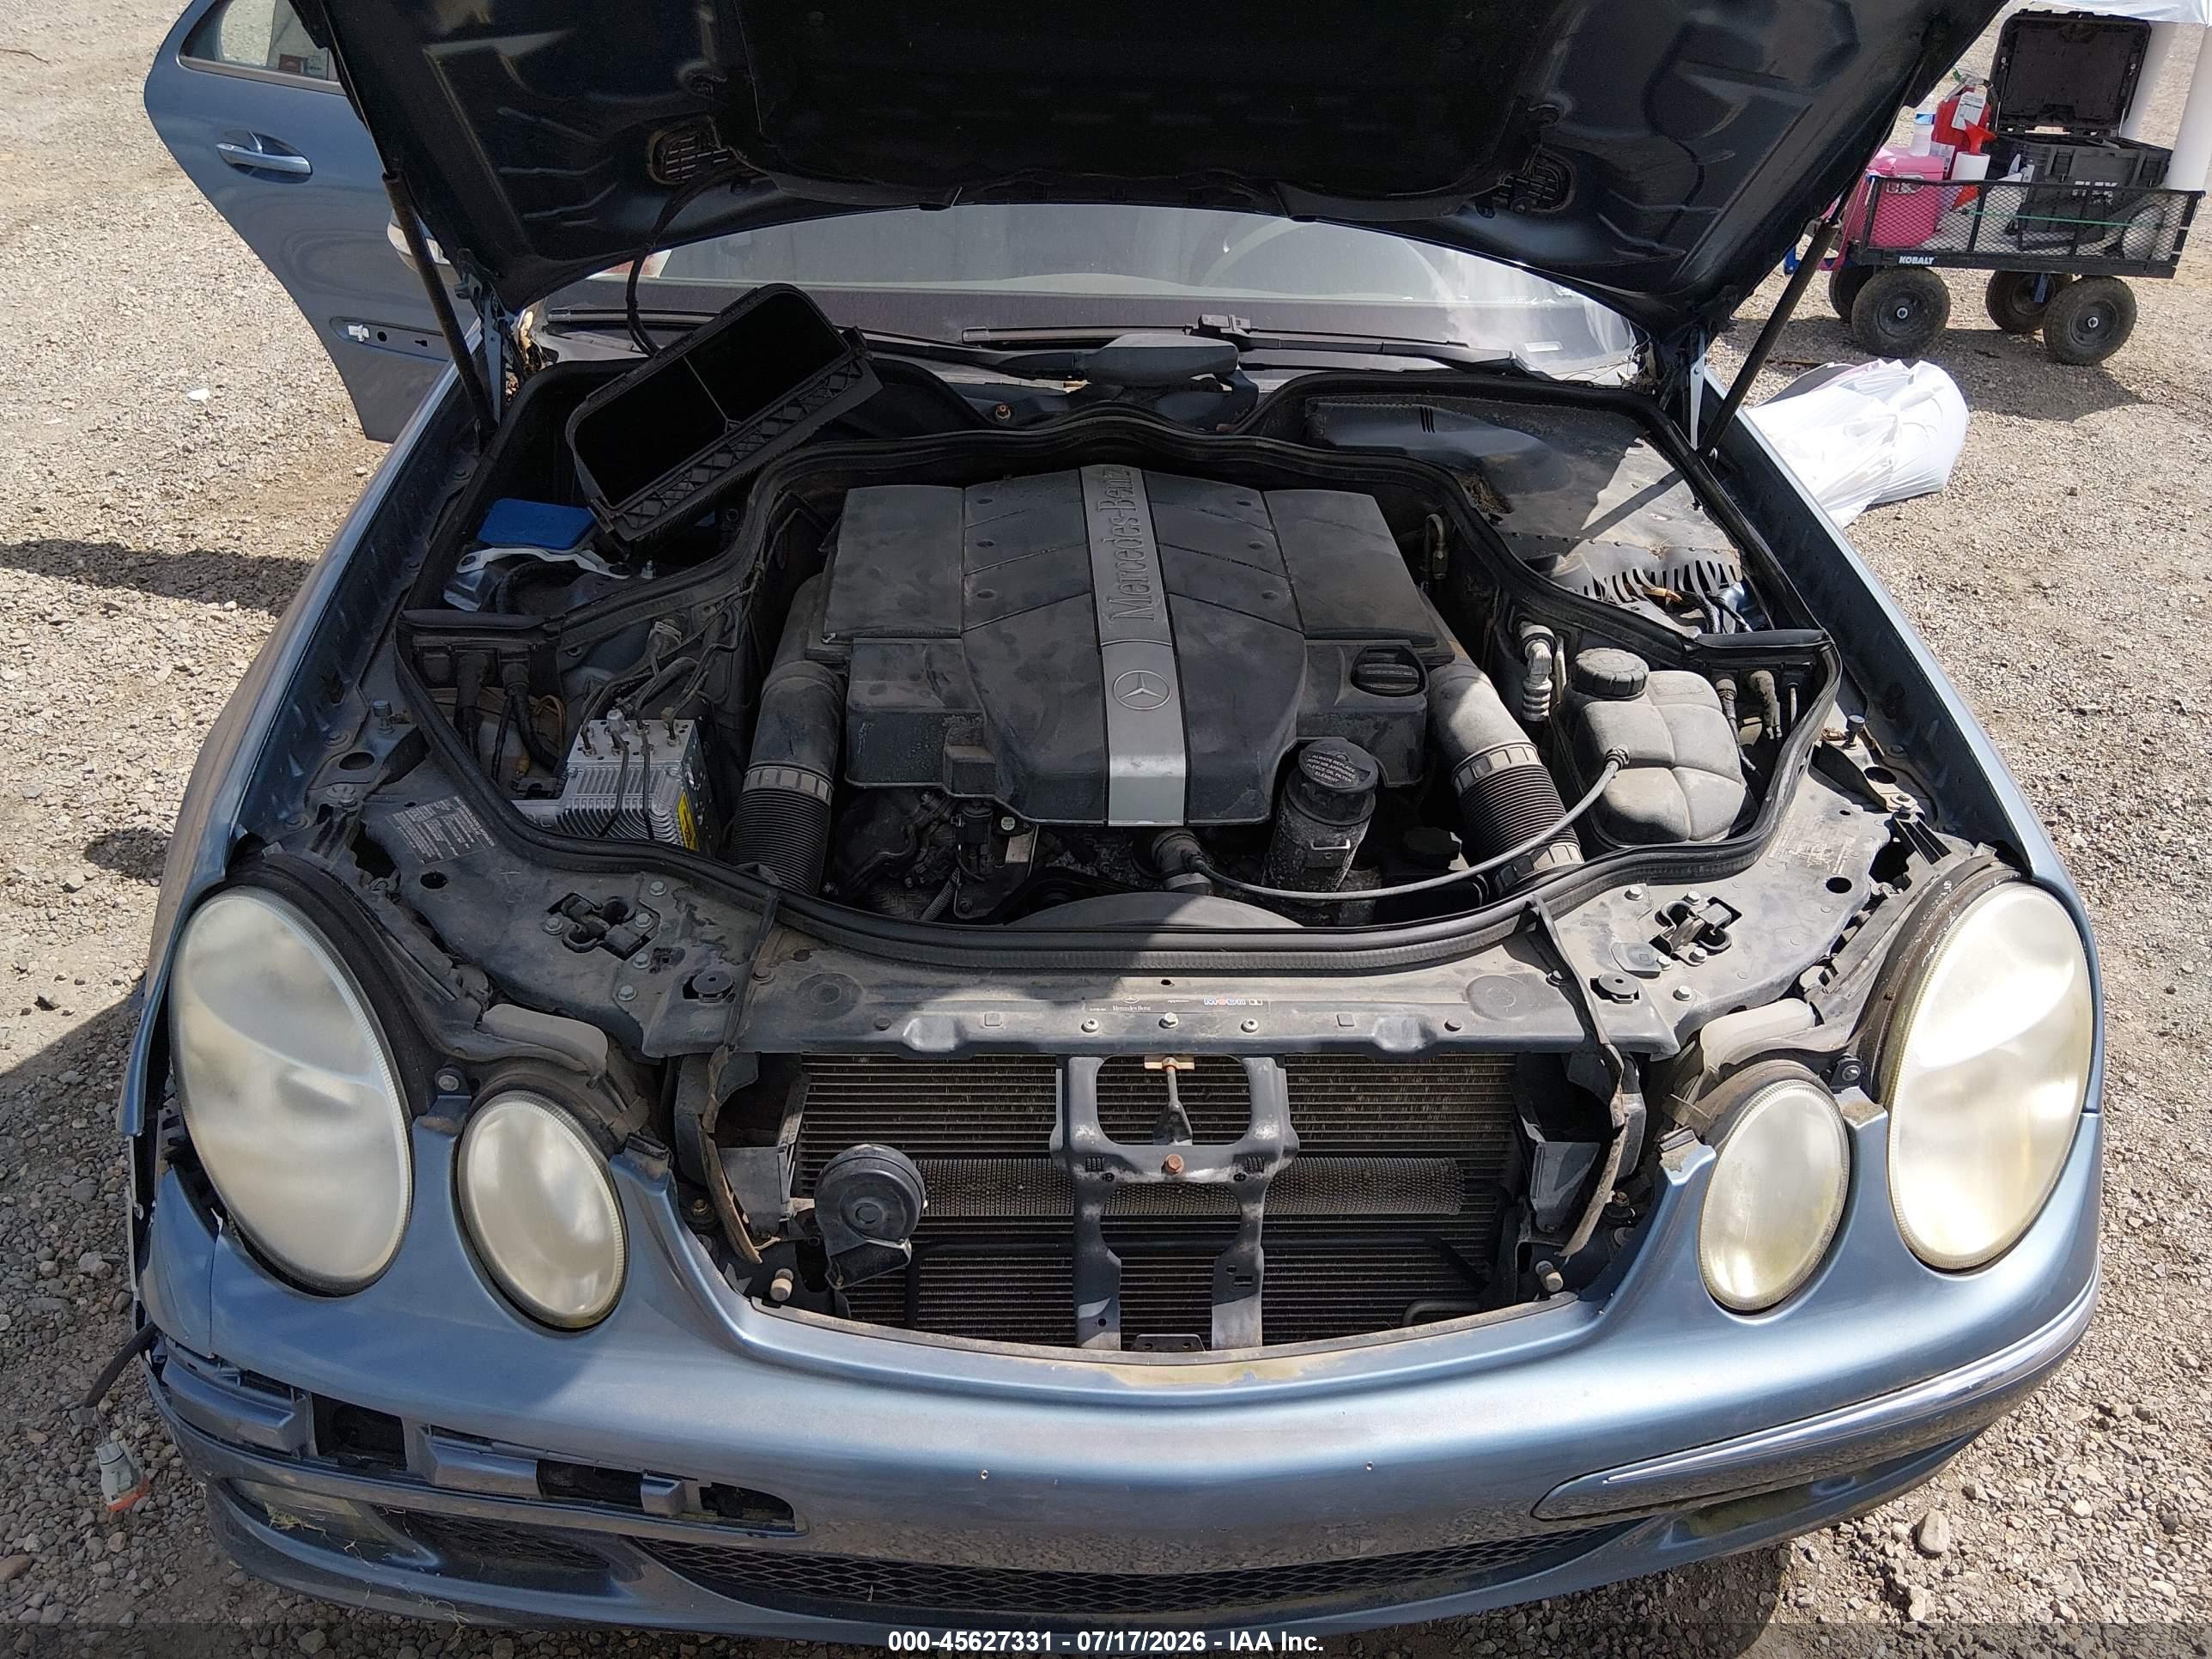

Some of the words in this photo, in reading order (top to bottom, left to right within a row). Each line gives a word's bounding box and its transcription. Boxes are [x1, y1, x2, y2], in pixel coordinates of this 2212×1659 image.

[1899, 255, 1934, 265] KOBALT
[1097, 468, 1156, 622] Mercedes-Benz
[1311, 754, 1333, 763] ALWAYS
[1333, 760, 1356, 773] REPLACE
[1315, 771, 1340, 783] ELEMENT
